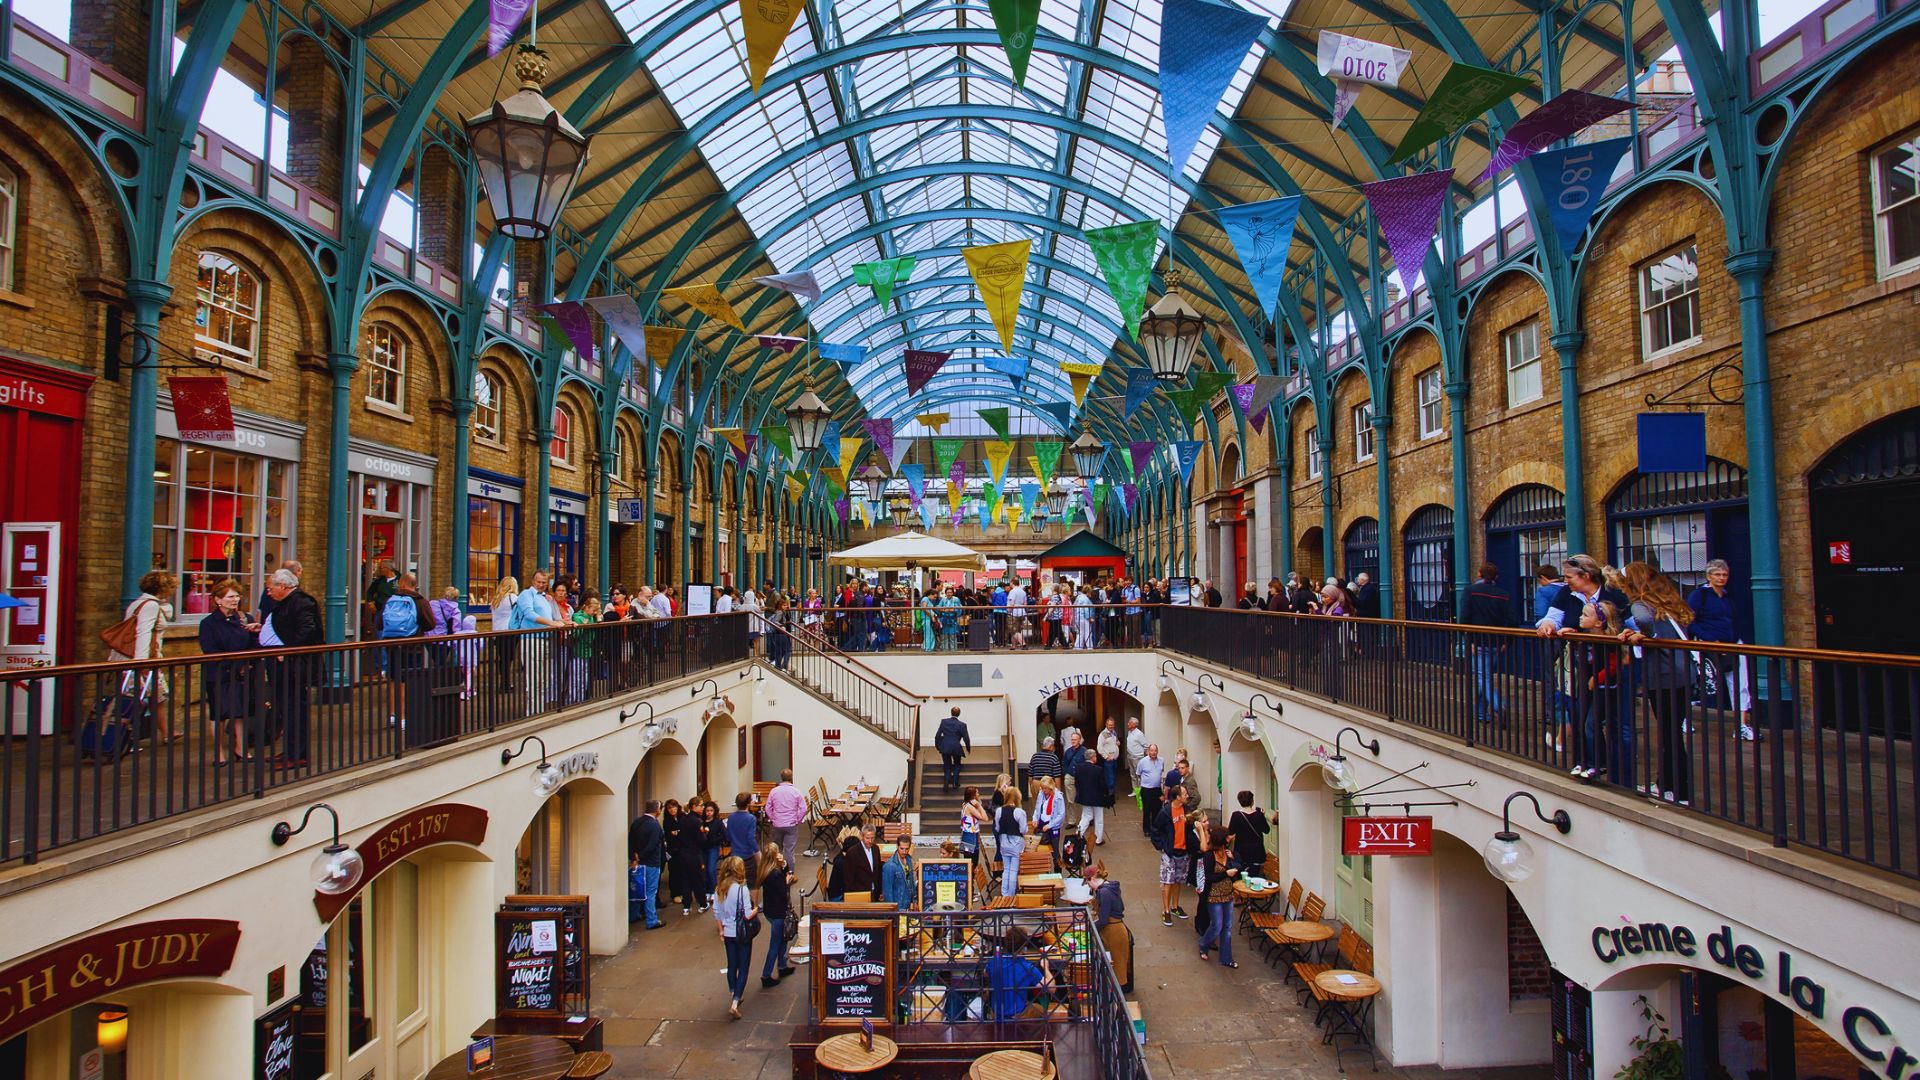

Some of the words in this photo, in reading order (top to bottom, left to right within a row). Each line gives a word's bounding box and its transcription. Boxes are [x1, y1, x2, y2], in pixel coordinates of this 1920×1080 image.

[1343, 55, 1387, 82] 2010
[1559, 150, 1594, 210] 180
[910, 362, 934, 372] 2010
[0, 381, 45, 405] gifts
[181, 431, 215, 441] REGENT
[365, 457, 412, 478] octopus
[1038, 673, 1139, 699] NAUTICALIA
[376, 823, 416, 862] EST.
[418, 812, 450, 839] 1787
[1360, 822, 1420, 841] EXIT
[843, 930, 873, 946] Open
[70, 953, 103, 989] &
[105, 933, 210, 987] JUDY
[511, 966, 553, 986] Night!
[827, 963, 886, 980] BREAKFAST
[841, 985, 868, 993] MONDAY
[1592, 915, 1698, 964] Crème
[1706, 925, 1765, 979] de
[1778, 951, 1826, 1020] la
[1842, 1006, 1920, 1080] Cr
[836, 996, 873, 1004] SATURDAY
